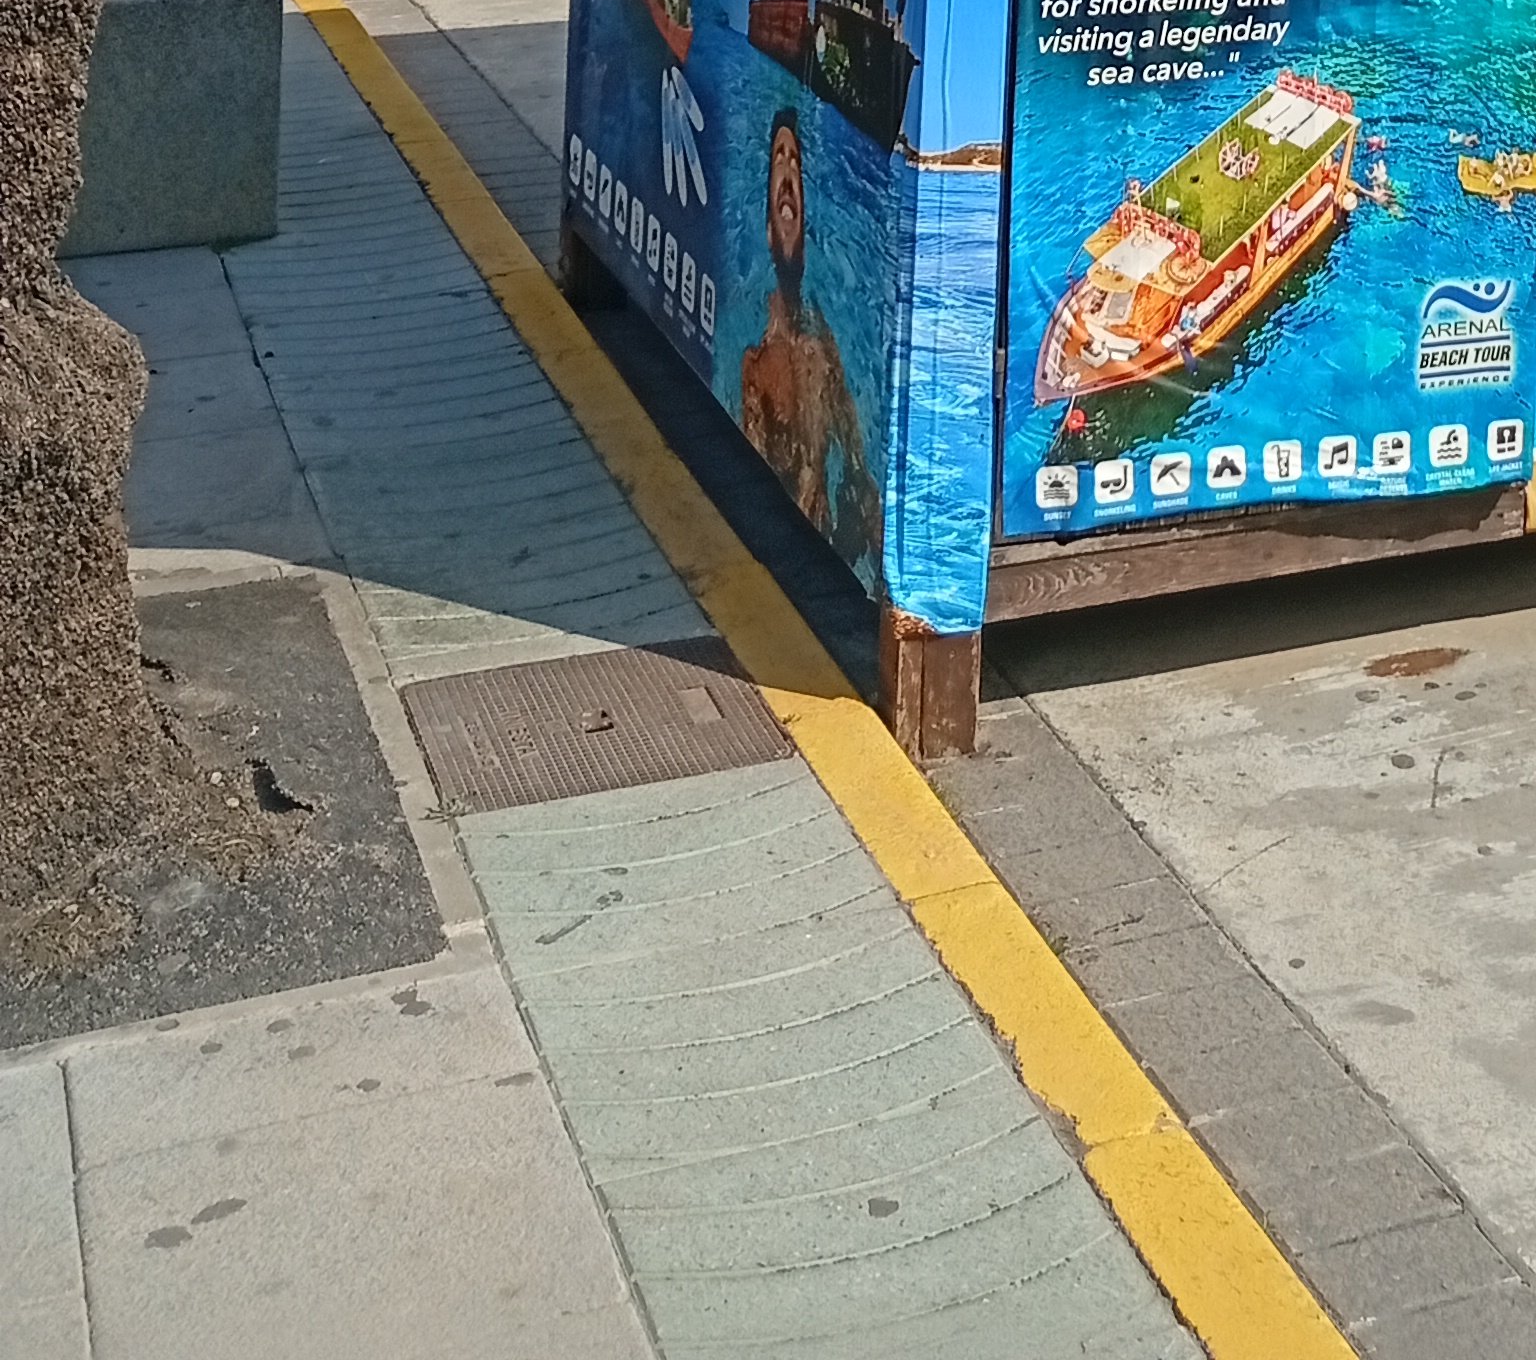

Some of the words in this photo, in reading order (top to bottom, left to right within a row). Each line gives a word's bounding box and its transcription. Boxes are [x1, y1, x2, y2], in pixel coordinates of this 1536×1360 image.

[1038, 25, 1134, 57] visiting
[1138, 30, 1155, 49] a
[1159, 16, 1291, 52] legendary
[1087, 64, 1135, 87] sea
[1420, 316, 1514, 340] ARENAL
[1419, 348, 1470, 370] BEACH
[1473, 344, 1512, 364] TOUR
[1420, 375, 1510, 390] EXPERIENCE
